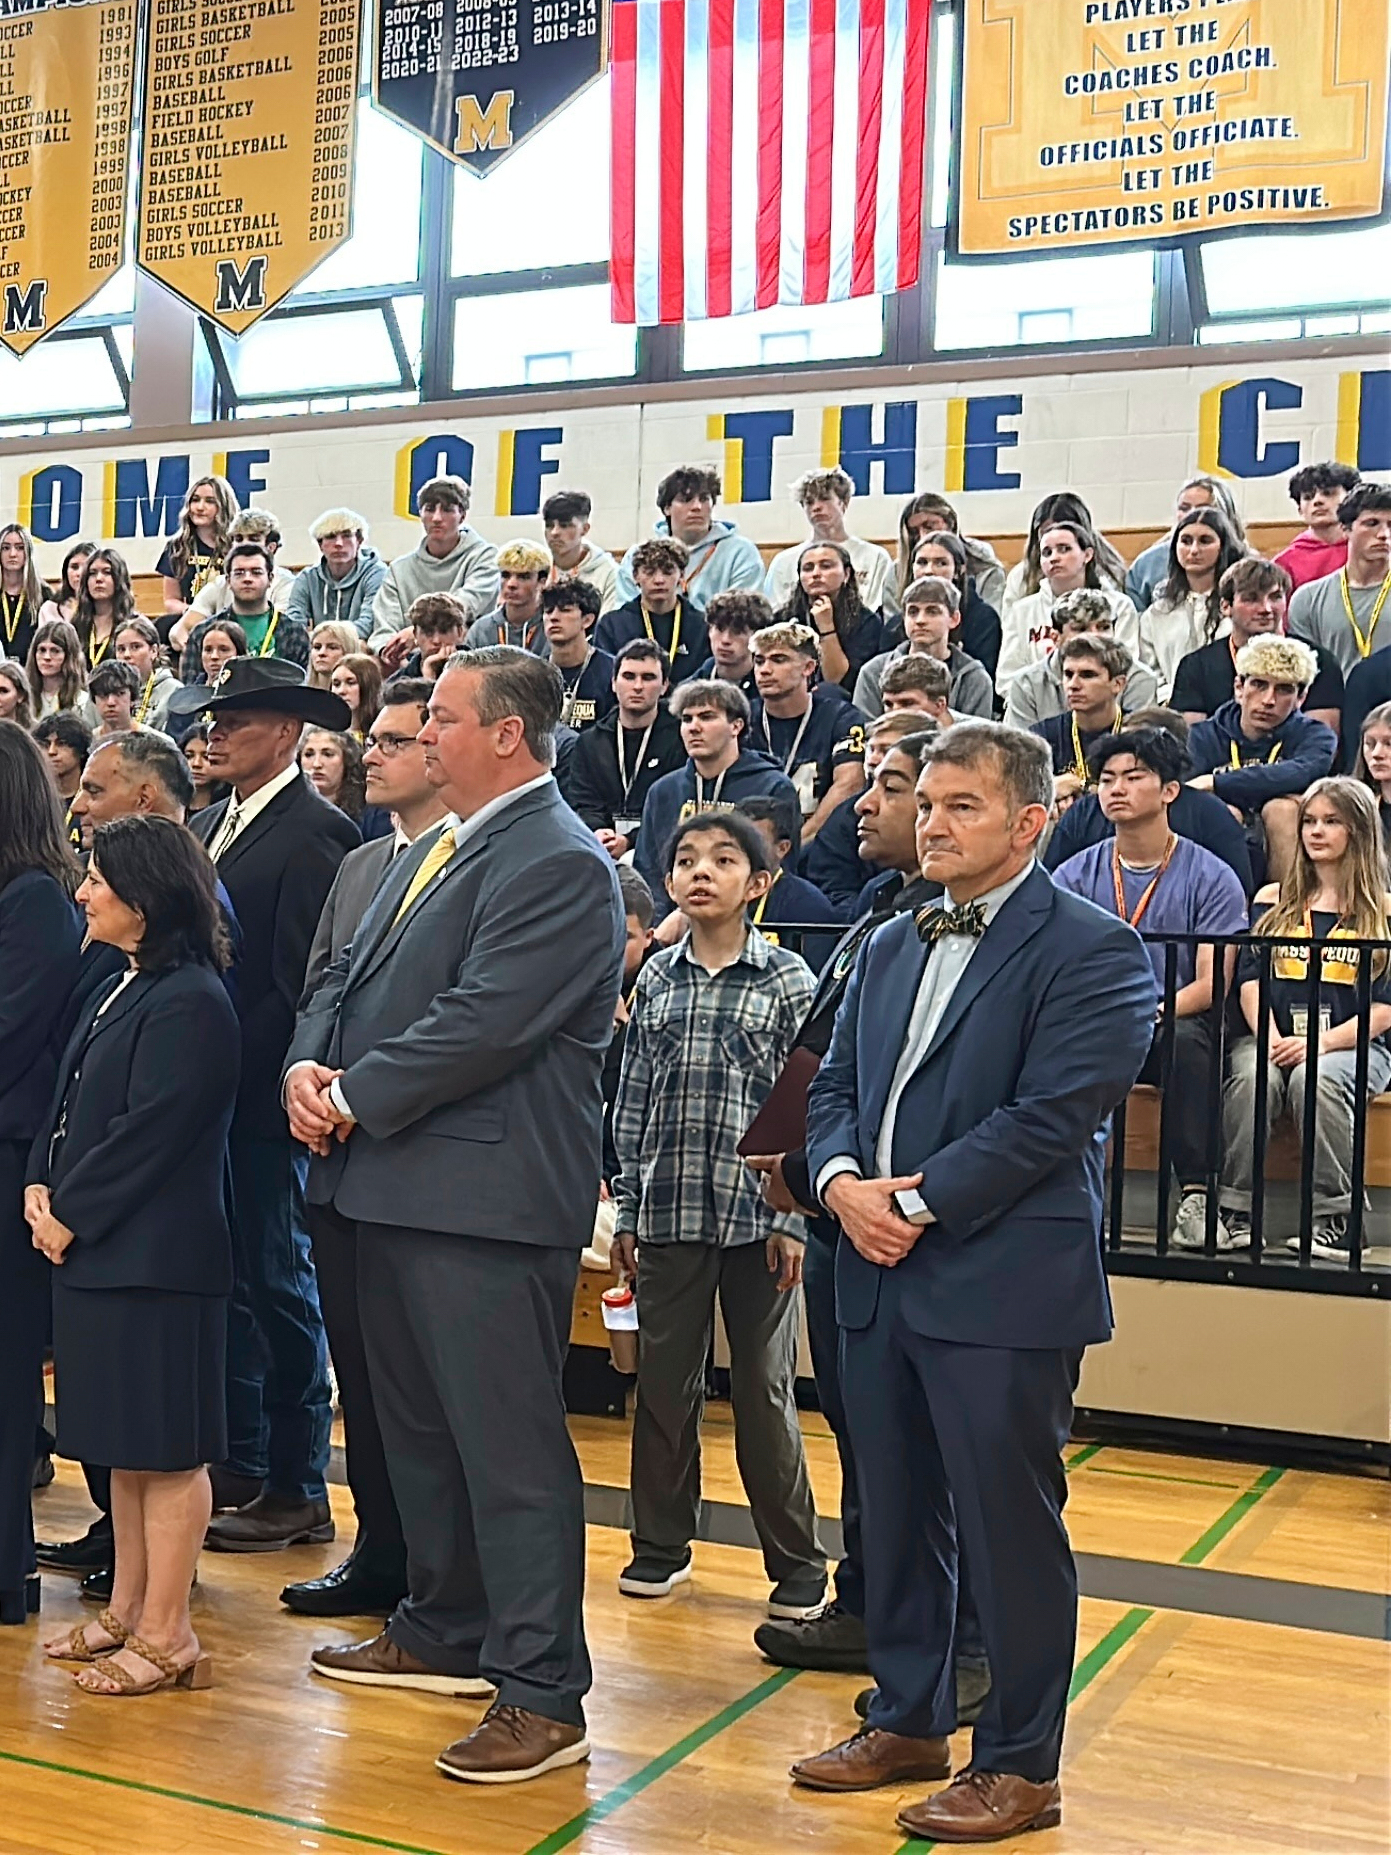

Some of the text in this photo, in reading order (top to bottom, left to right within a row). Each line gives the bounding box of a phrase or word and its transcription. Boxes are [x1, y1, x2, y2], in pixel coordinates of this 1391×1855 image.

[100, 6, 132, 25] 1981
[156, 0, 295, 34] GIRLS BASKETBALL
[158, 0, 196, 15] GIRLS
[384, 2, 444, 26] 2007-08
[534, 0, 596, 24] 2013-14
[99, 26, 131, 44] 1993
[155, 6, 355, 53] GIRLS SOCCER 2005
[382, 29, 516, 61] 2014-15 2018-19
[384, 11, 596, 45] 2010-11 2012-13 2019-20
[1126, 21, 1219, 53] LET THE
[99, 45, 130, 62] 1994
[155, 26, 354, 72] BOYS GOLF 2005
[381, 46, 519, 80] 2020-21 2022-23
[98, 64, 129, 81] 1996
[154, 46, 353, 91] GIRLS BASKETBALL 2006
[1064, 47, 1278, 96] COACHES COACH.
[97, 83, 128, 100] 1997
[153, 66, 352, 110] BASEBALL 2006
[96, 102, 128, 119] 1997
[152, 85, 351, 129] FIELD HOCKEY 2006
[453, 89, 514, 154] M
[1124, 91, 1216, 122] LET THE
[95, 121, 126, 138] 1998
[151, 105, 349, 148] BASEBALL 2007
[1040, 117, 1300, 166] OFFICIALS OFFICIATE.
[94, 140, 125, 157] 1998
[150, 125, 349, 167] GIRLS VOLLEYBALL 2007
[94, 158, 124, 176] 1999
[149, 144, 348, 186] BASEBALL 2008
[1123, 161, 1212, 192] LET THE
[93, 177, 123, 194] 2000
[148, 164, 347, 205] BASEBALL 2009
[92, 196, 121, 213] 2003
[147, 184, 346, 224] GIRLS SOCCER 2010
[1009, 187, 1330, 238] SPECTATORS BE POSITIVE.
[91, 215, 120, 231] 2003
[146, 203, 345, 242] BOYS VOLLEYBALL 2011
[90, 234, 119, 250] 2004
[145, 223, 343, 261] GIRLS VOLLEYBALL 2013
[89, 252, 118, 269] 2004
[214, 254, 268, 314] M
[2, 279, 48, 334] M
[394, 426, 563, 522] OF
[706, 393, 1023, 504] THE
